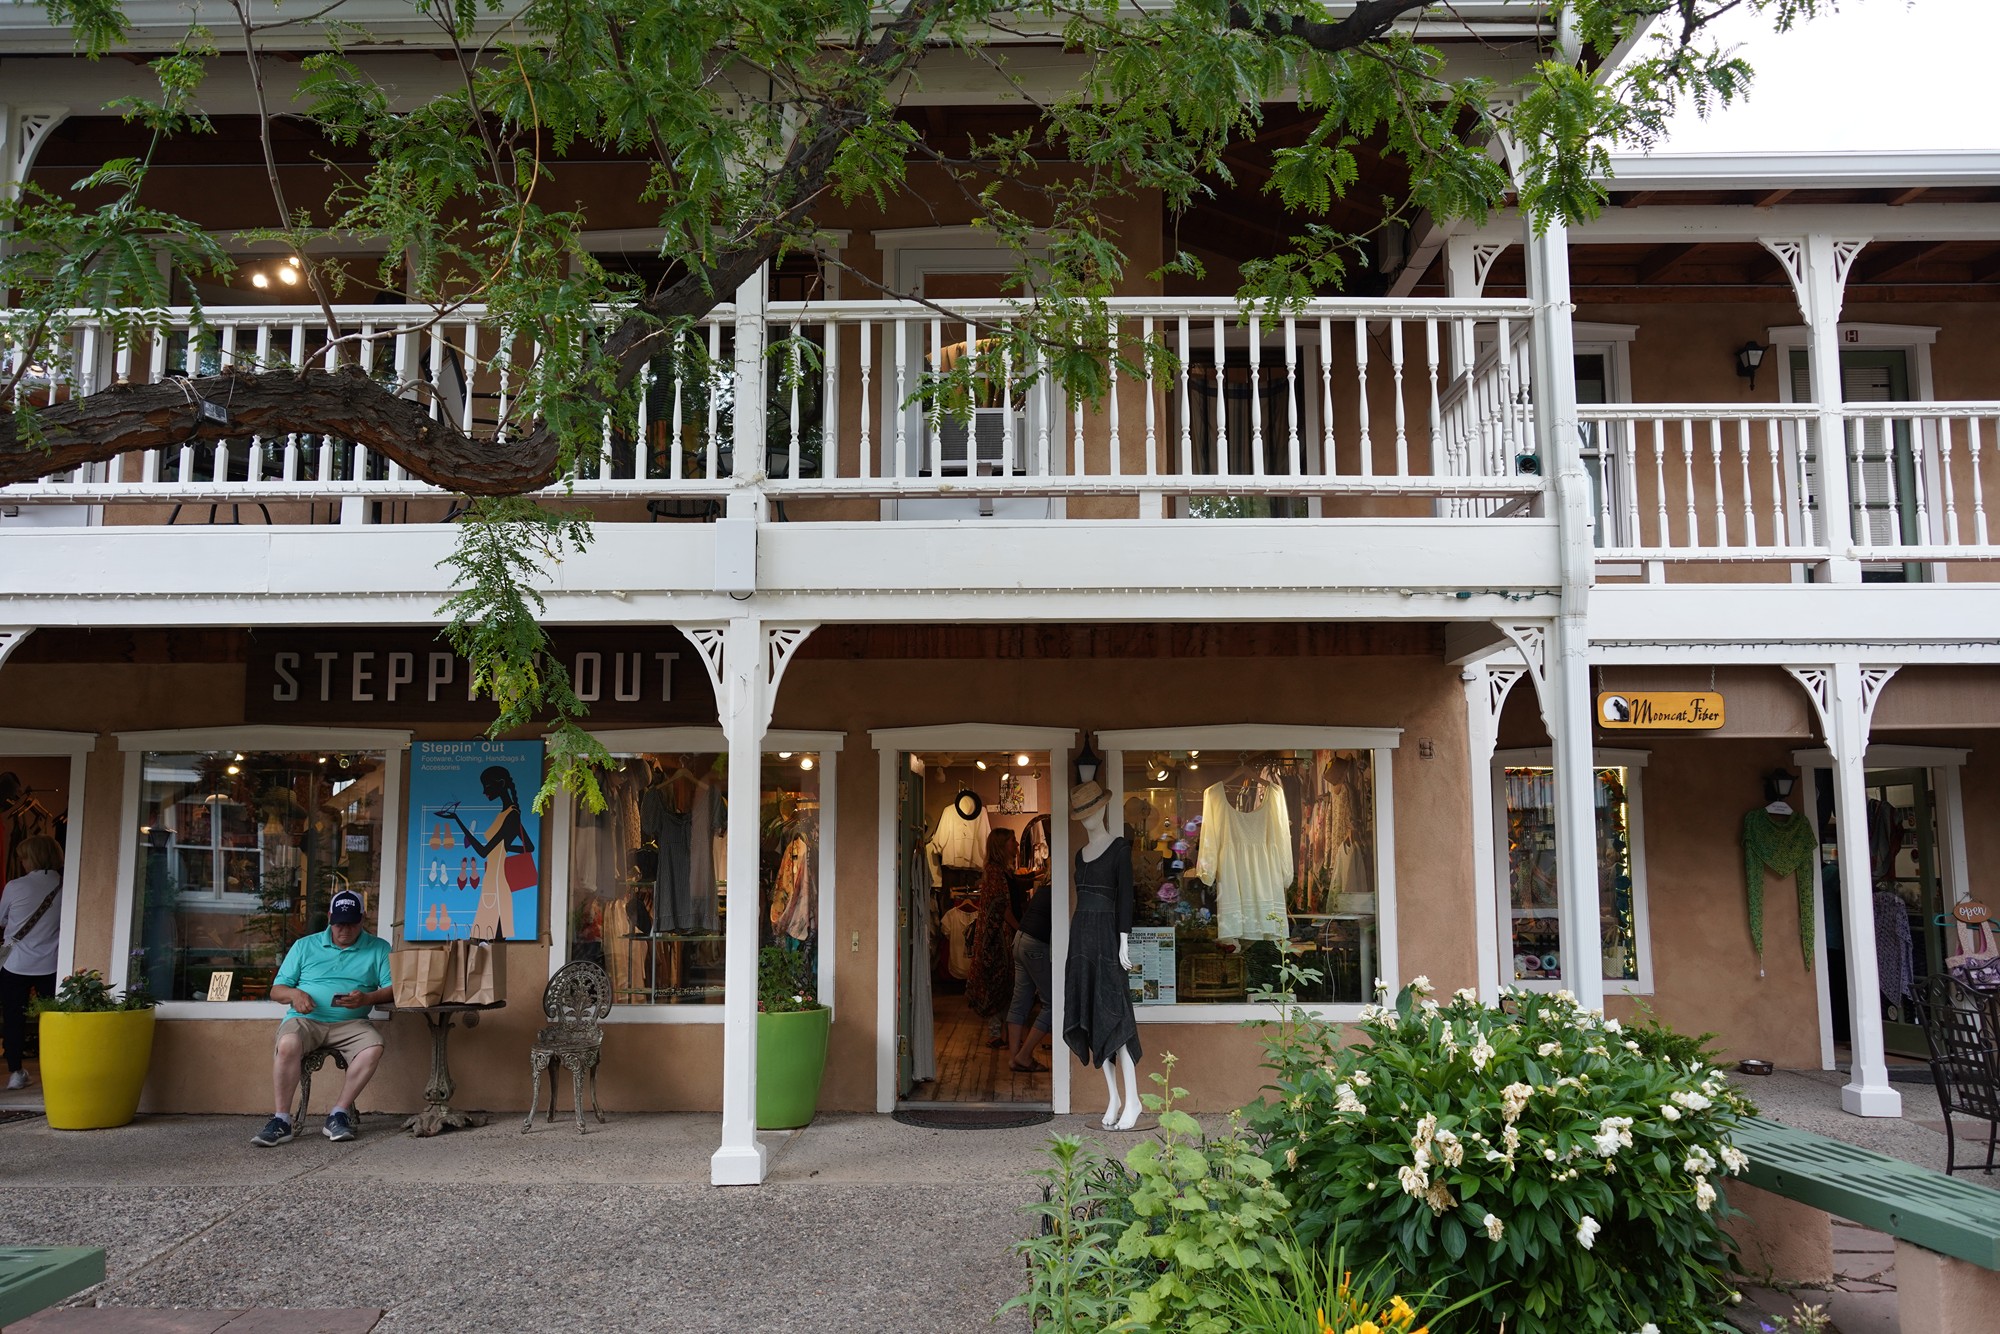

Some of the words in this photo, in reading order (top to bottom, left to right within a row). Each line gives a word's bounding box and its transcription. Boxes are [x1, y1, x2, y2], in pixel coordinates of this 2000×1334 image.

[575, 652, 680, 702] OUT
[1631, 698, 1688, 725] Mooncat
[1687, 698, 1720, 723] Fiber
[421, 741, 476, 755] Steppin'
[481, 741, 505, 753] Out
[485, 755, 519, 764] Handbags
[1959, 906, 1987, 920] open
